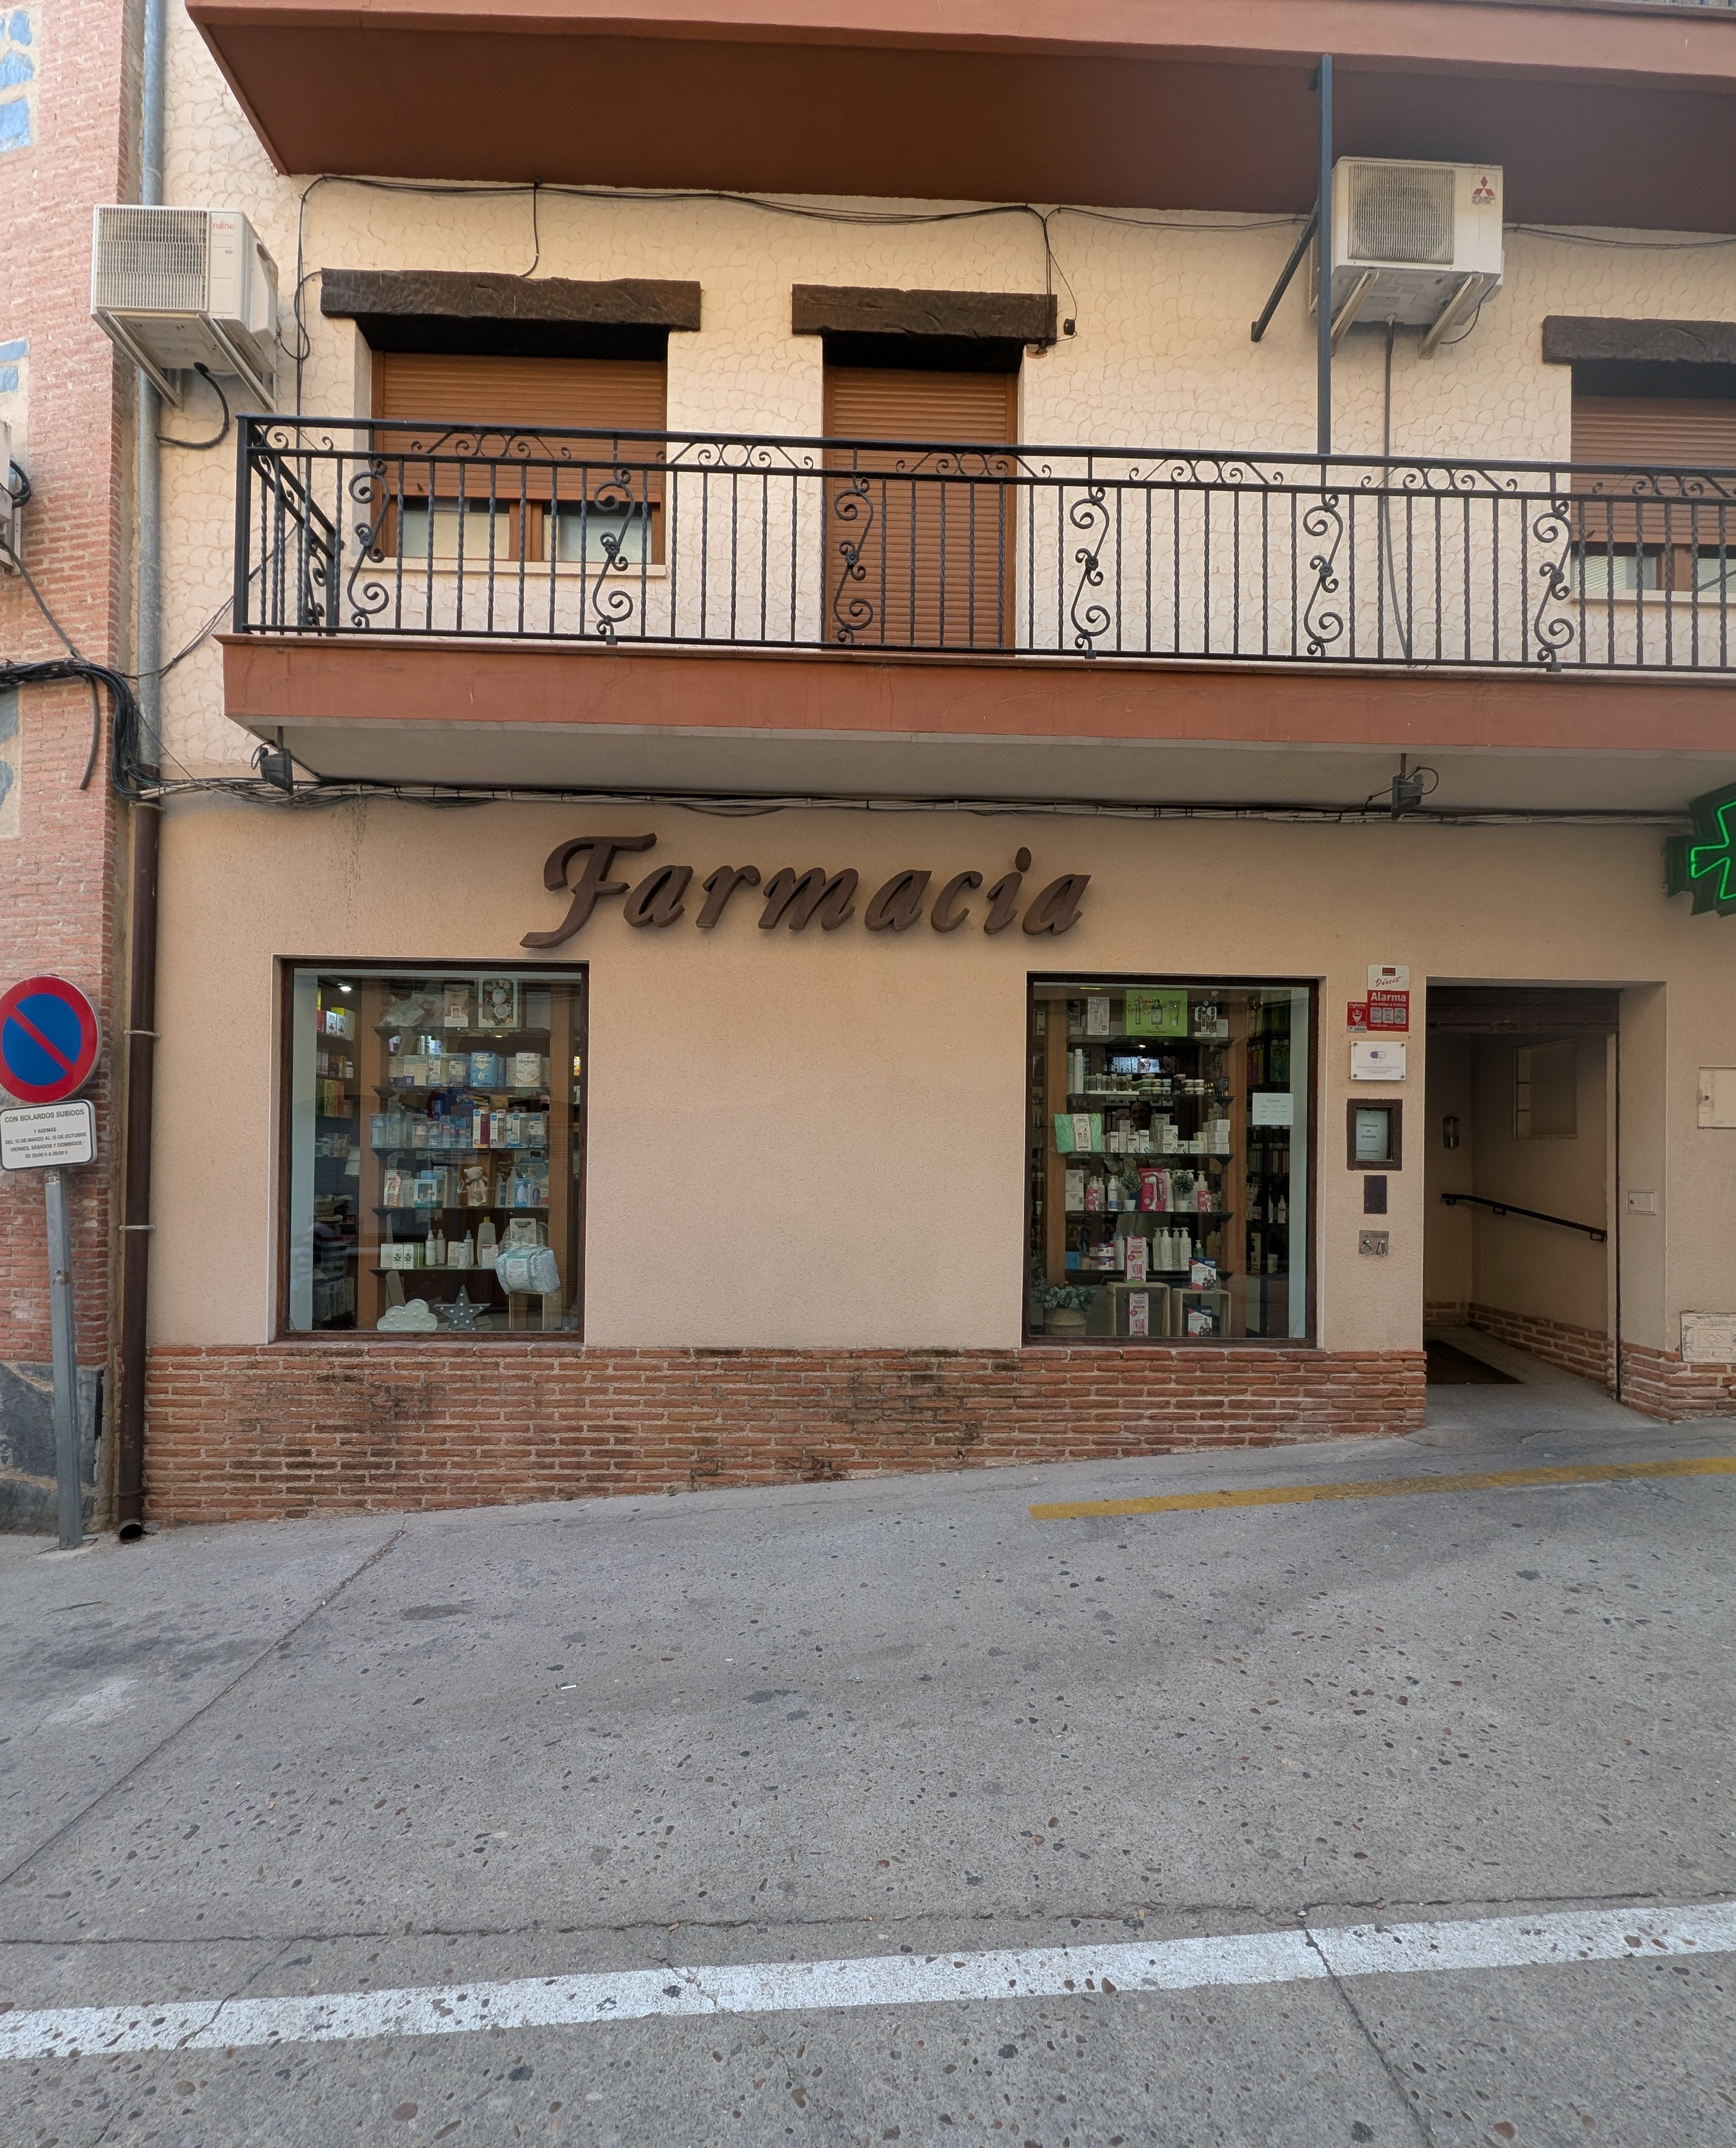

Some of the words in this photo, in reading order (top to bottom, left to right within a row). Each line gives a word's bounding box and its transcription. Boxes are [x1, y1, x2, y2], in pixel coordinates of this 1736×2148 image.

[519, 832, 1092, 949] Farmacia
[1375, 976, 1403, 987] Direct
[1370, 992, 1406, 1002] Alarma
[20, 1112, 54, 1121] BOLARDOS
[57, 1109, 84, 1117] SUBIDOS
